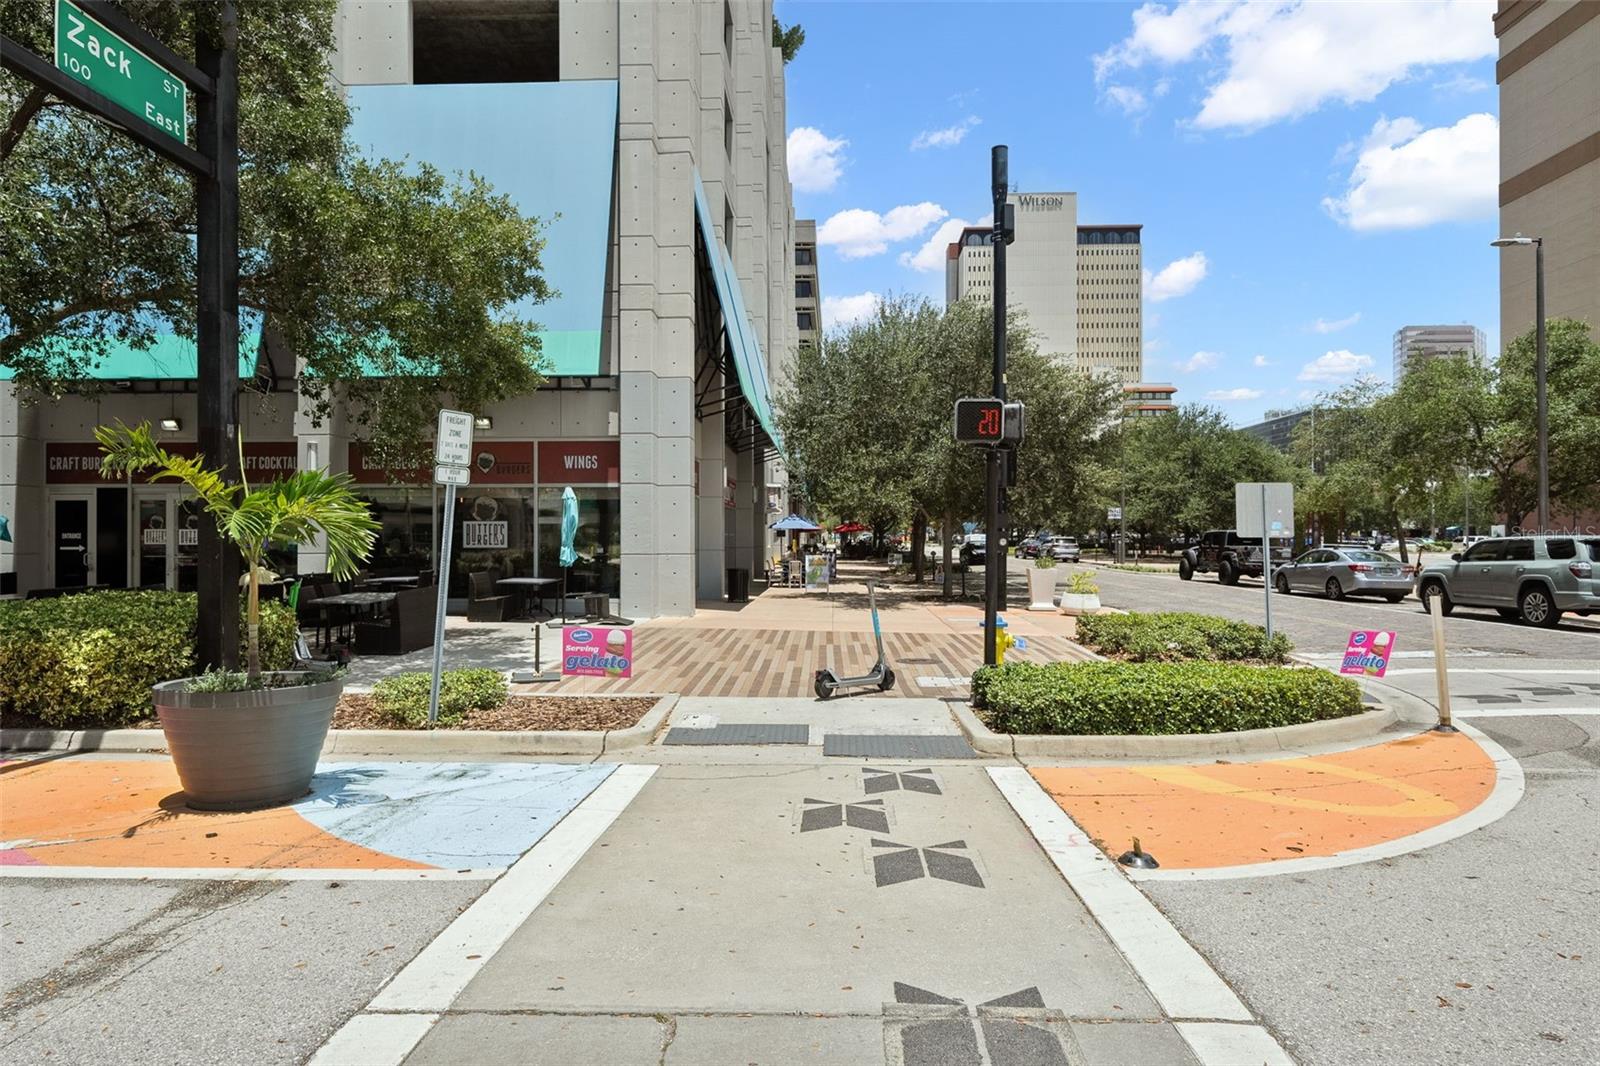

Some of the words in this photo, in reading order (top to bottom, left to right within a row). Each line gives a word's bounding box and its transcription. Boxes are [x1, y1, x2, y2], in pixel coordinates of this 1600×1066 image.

[67, 14, 131, 79] Zack
[163, 80, 179, 98] ST
[64, 53, 91, 80] 100
[145, 101, 180, 136] East
[1018, 195, 1063, 206] WILSON
[446, 416, 466, 425] FREIGHT
[978, 409, 999, 434] 20
[449, 430, 462, 438] ZONE
[49, 456, 80, 470] CRAFT
[564, 455, 598, 469] WINGS
[565, 645, 600, 653] Serving
[566, 653, 629, 670] gelato
[1343, 653, 1385, 669] gelato
